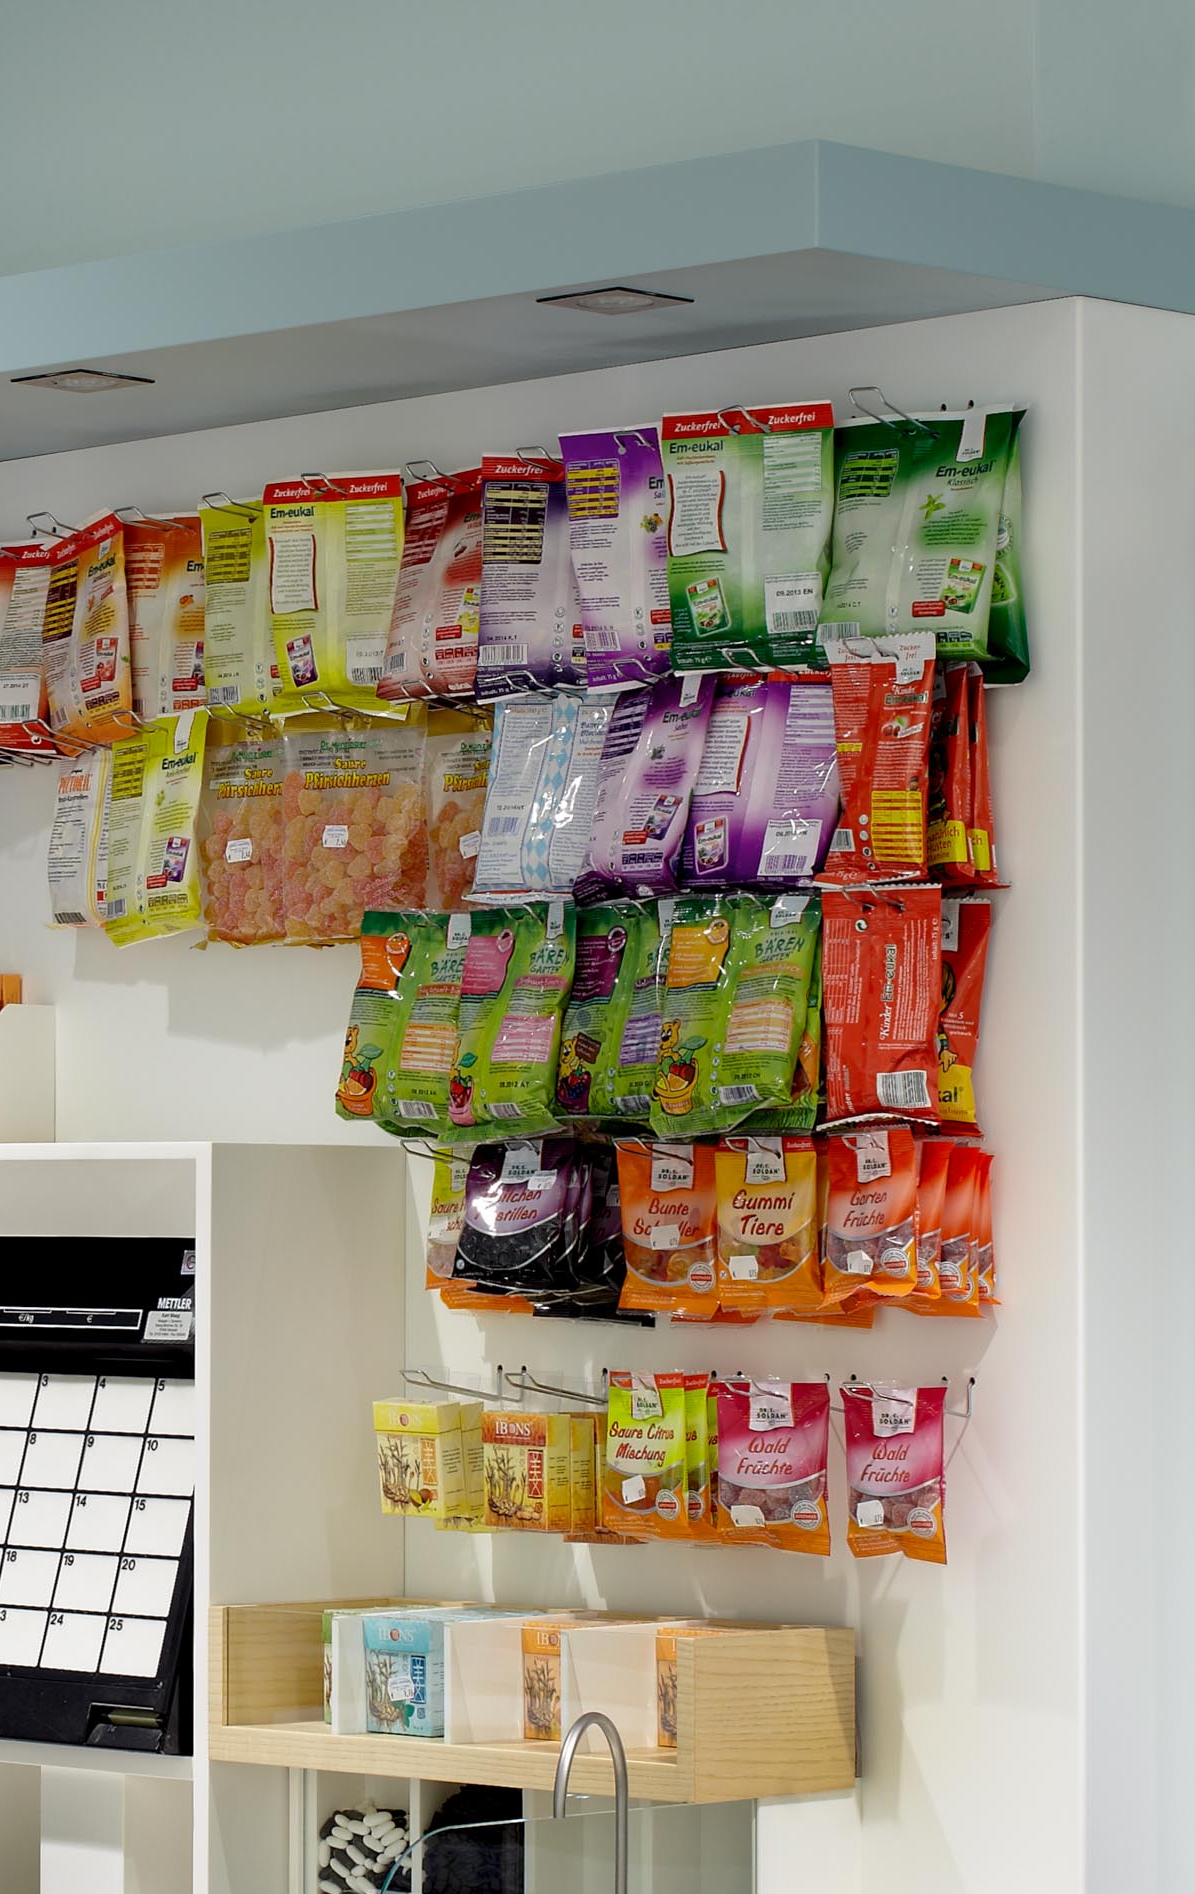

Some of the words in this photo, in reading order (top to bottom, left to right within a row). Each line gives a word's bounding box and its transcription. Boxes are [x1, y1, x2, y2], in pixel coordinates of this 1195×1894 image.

[674, 420, 721, 433] Zuckerfrei
[768, 412, 816, 426] Zuckerfrei
[669, 440, 724, 454] Em-eukal
[935, 461, 994, 478] Em-eukal
[273, 487, 310, 499] Zuckerfrei
[349, 482, 388, 494] Zuckerfrei
[270, 505, 315, 519] Em-eukal
[305, 771, 391, 789] Pfirsichherzen
[732, 1189, 795, 1210] Gummi
[850, 1190, 887, 1206] Garten
[648, 1197, 689, 1216] Bunte
[740, 1214, 785, 1236] Tiere
[843, 1210, 885, 1228] Früchte
[157, 1297, 192, 1310] METTLER
[86, 1314, 94, 1324] €
[41, 1375, 49, 1387] 3
[99, 1378, 107, 1389] 4
[158, 1380, 165, 1391] 5
[879, 1417, 909, 1425] SOLDAN
[495, 1421, 531, 1437] IBONS
[609, 1421, 642, 1440] Saure
[647, 1423, 674, 1440] Citrus
[29, 1433, 37, 1445] 8
[87, 1436, 95, 1448] 9
[147, 1439, 158, 1451] 10
[748, 1436, 791, 1454] Wald
[616, 1443, 666, 1467] Mischung
[871, 1443, 909, 1461] Wald
[736, 1457, 793, 1476] Früchte
[861, 1463, 910, 1483] Früchte
[18, 1491, 30, 1504] 13
[76, 1495, 87, 1507] 14
[134, 1498, 146, 1511] 15
[6, 1550, 17, 1562] 18
[64, 1554, 75, 1566] 19
[121, 1558, 136, 1571] 20
[50, 1614, 64, 1625] 24
[109, 1618, 123, 1631] 25
